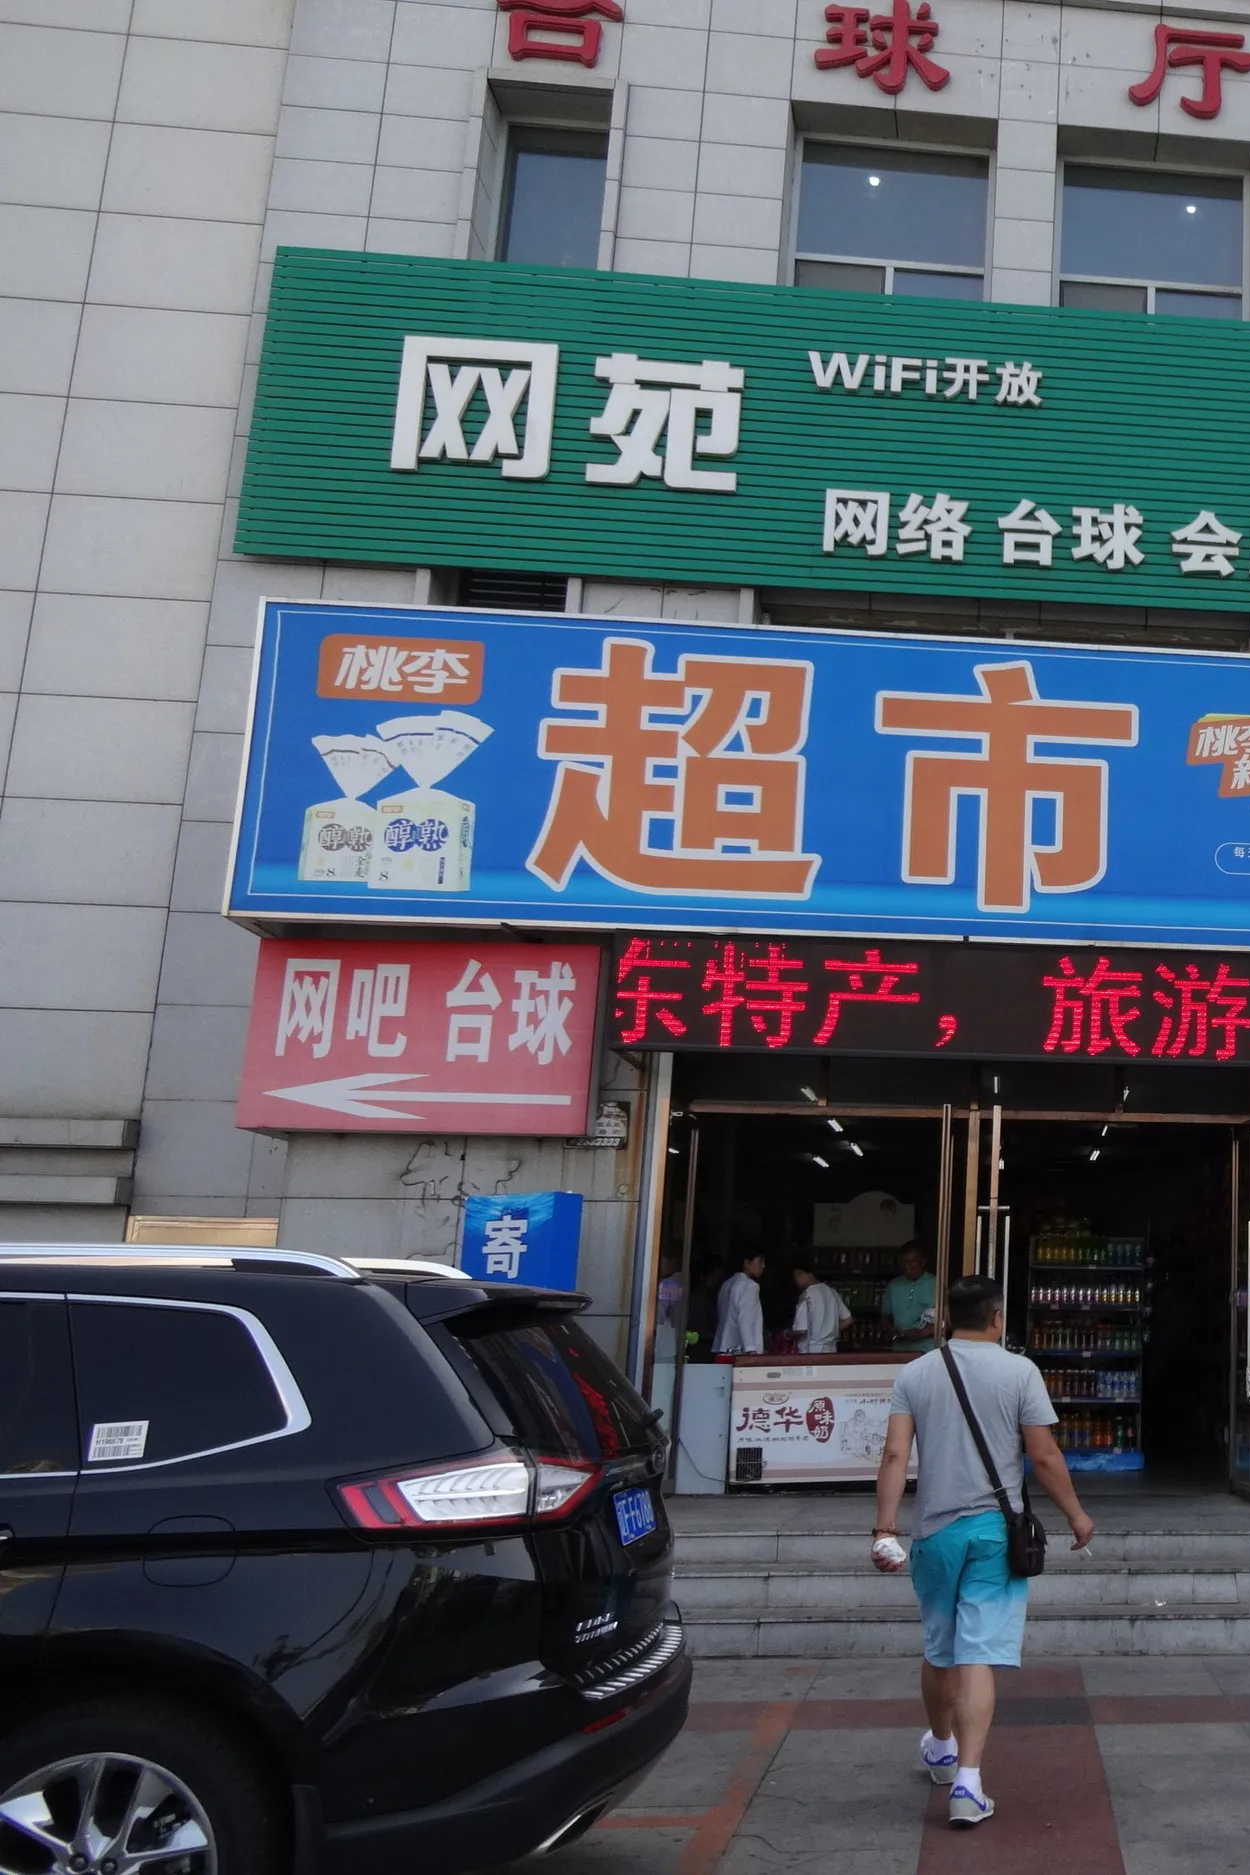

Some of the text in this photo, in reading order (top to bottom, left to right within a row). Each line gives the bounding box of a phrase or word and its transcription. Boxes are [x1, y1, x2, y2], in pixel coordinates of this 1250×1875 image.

[390, 334, 745, 493] 网苑
[808, 350, 1043, 405] WiFi开放
[822, 488, 973, 562] 网络
[998, 499, 1146, 571] 台球
[334, 644, 470, 694] 桃李
[527, 636, 1138, 913] 超市
[275, 957, 574, 1066] 网吧 台球
[482, 1214, 528, 1279] 寄
[736, 1407, 804, 1433] 德华
